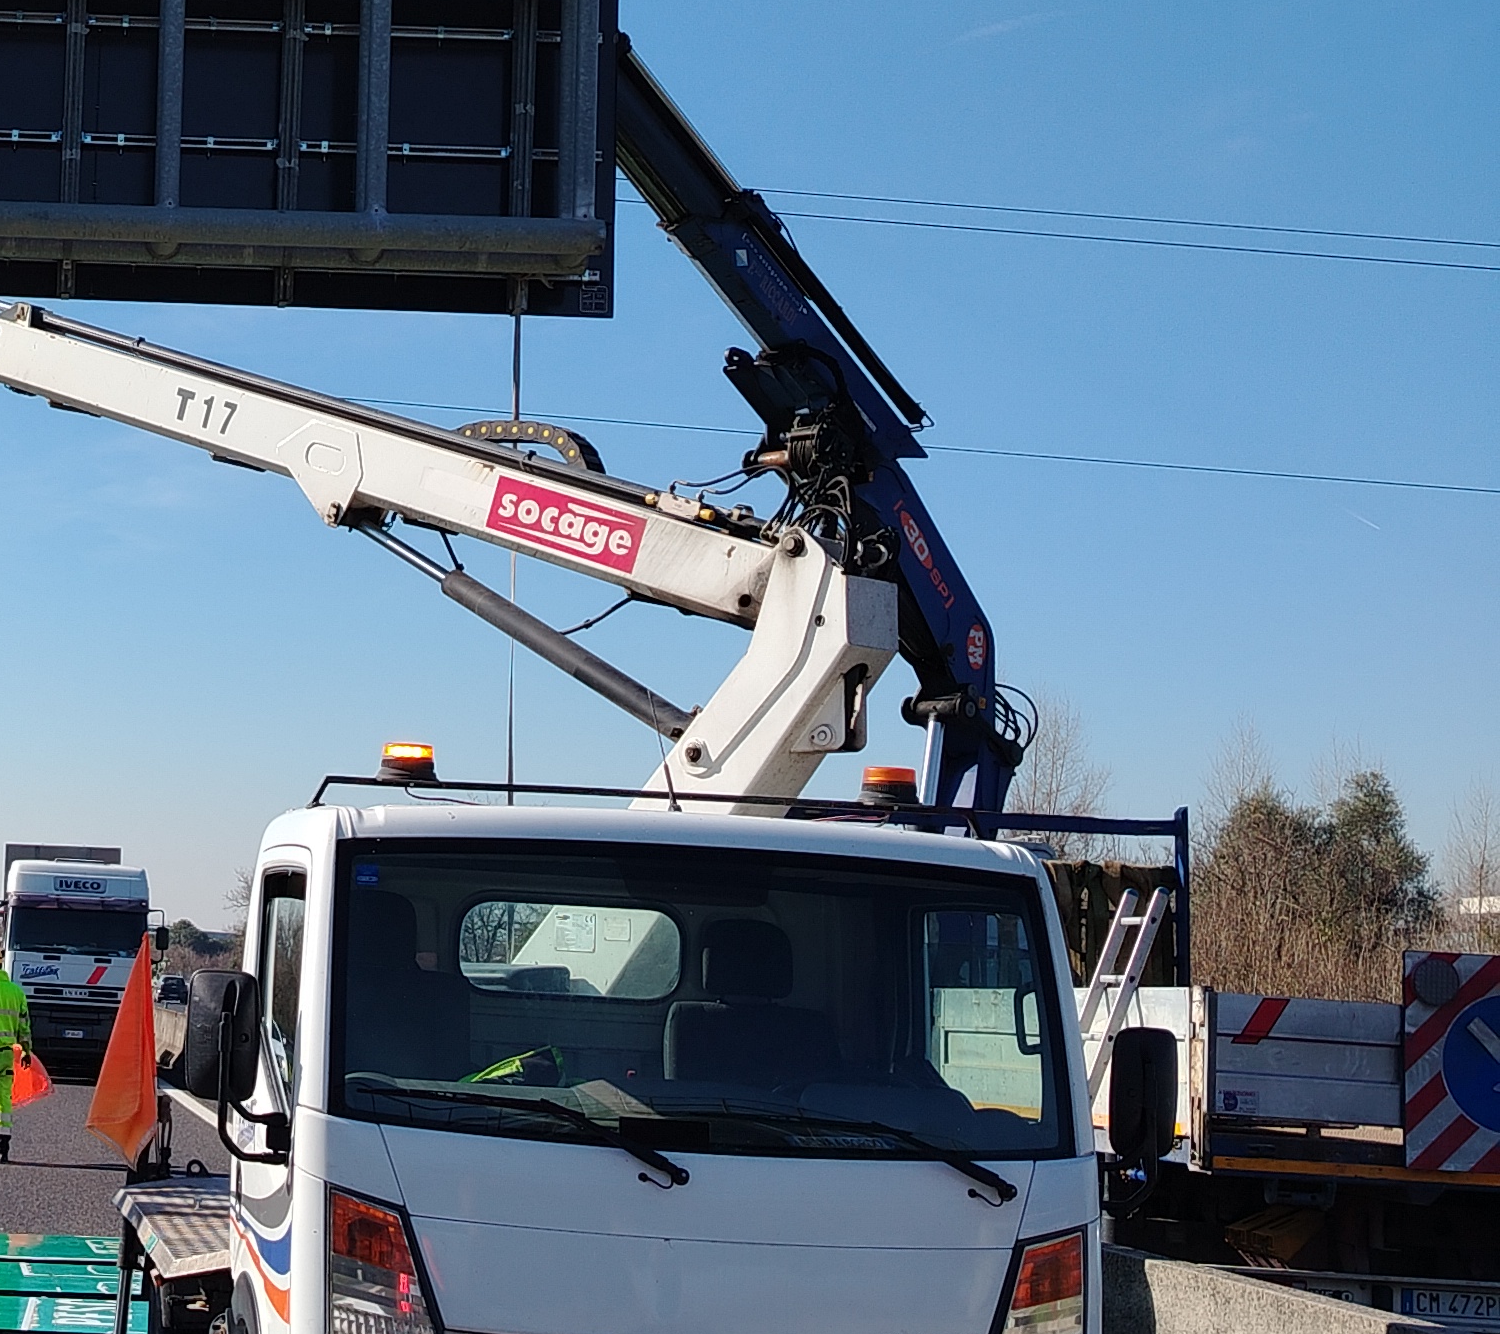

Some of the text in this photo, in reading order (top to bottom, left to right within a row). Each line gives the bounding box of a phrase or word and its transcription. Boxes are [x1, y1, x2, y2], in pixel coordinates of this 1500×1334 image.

[176, 386, 238, 435] T17
[498, 493, 632, 556] socage
[967, 628, 984, 666] PM
[58, 878, 102, 892] IVECO
[1416, 1291, 1441, 1314] CM
[1448, 1293, 1500, 1317] 472P
